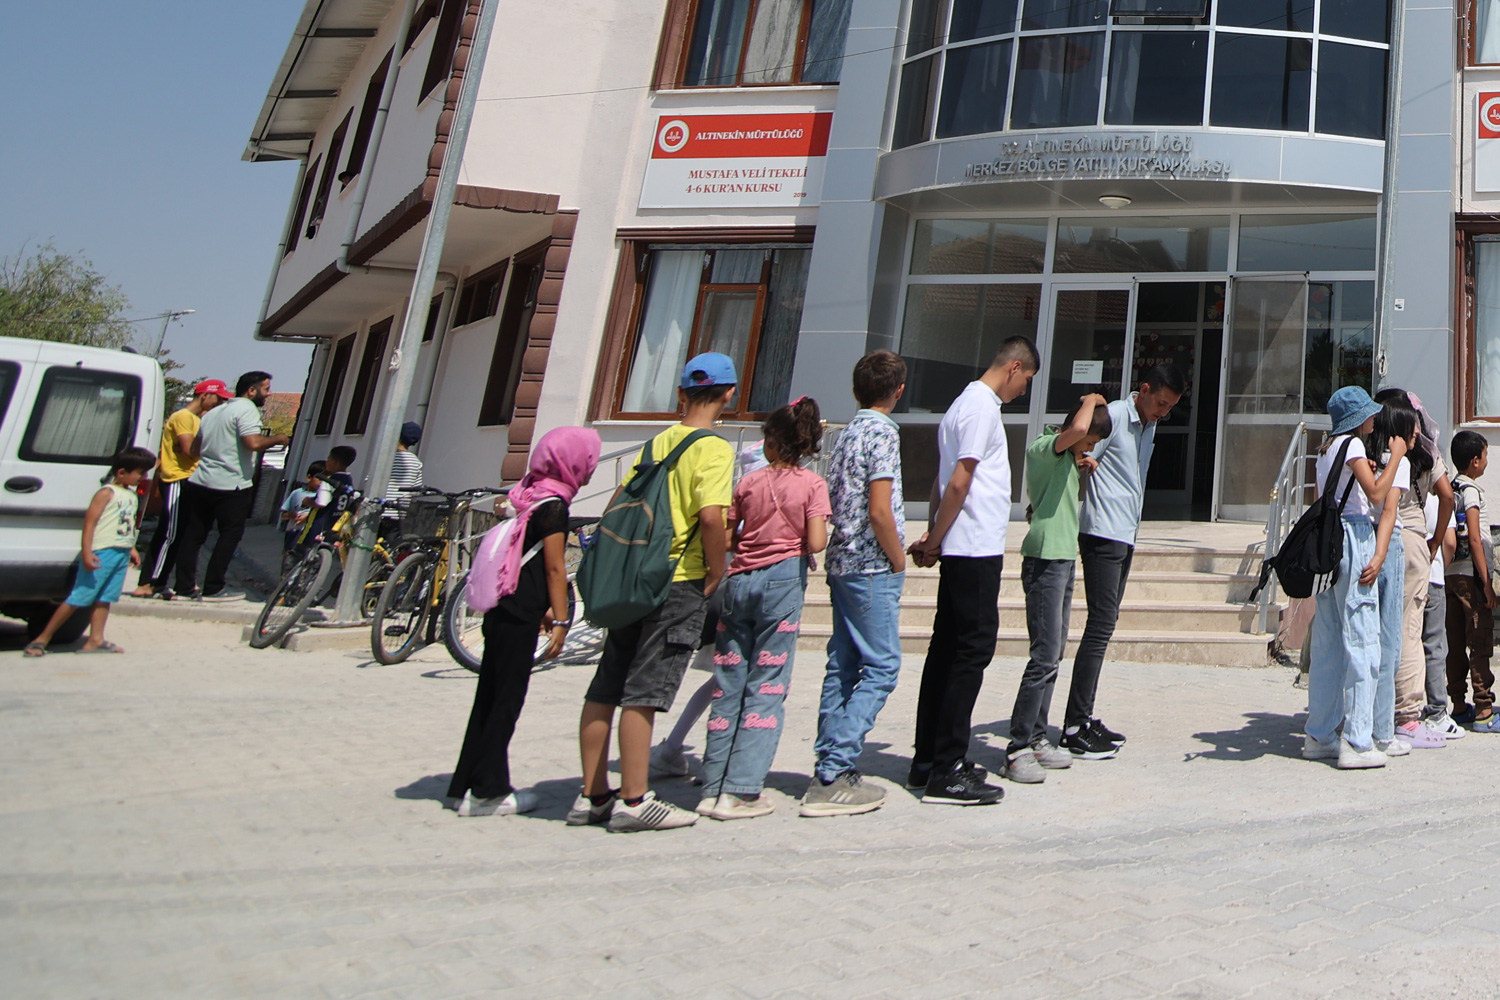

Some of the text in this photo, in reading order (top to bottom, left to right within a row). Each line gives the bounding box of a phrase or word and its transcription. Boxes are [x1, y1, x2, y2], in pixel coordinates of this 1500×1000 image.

[695, 128, 804, 141] ALTINEKİN MÜFTÜLÜĞÜ
[688, 166, 808, 179] MUSTAFA VELİ TEKELİ
[965, 162, 1017, 178] MERKEZ
[1020, 155, 1065, 173] BÖLGE
[685, 184, 702, 194] 4-6
[745, 183, 783, 193] KURSU
